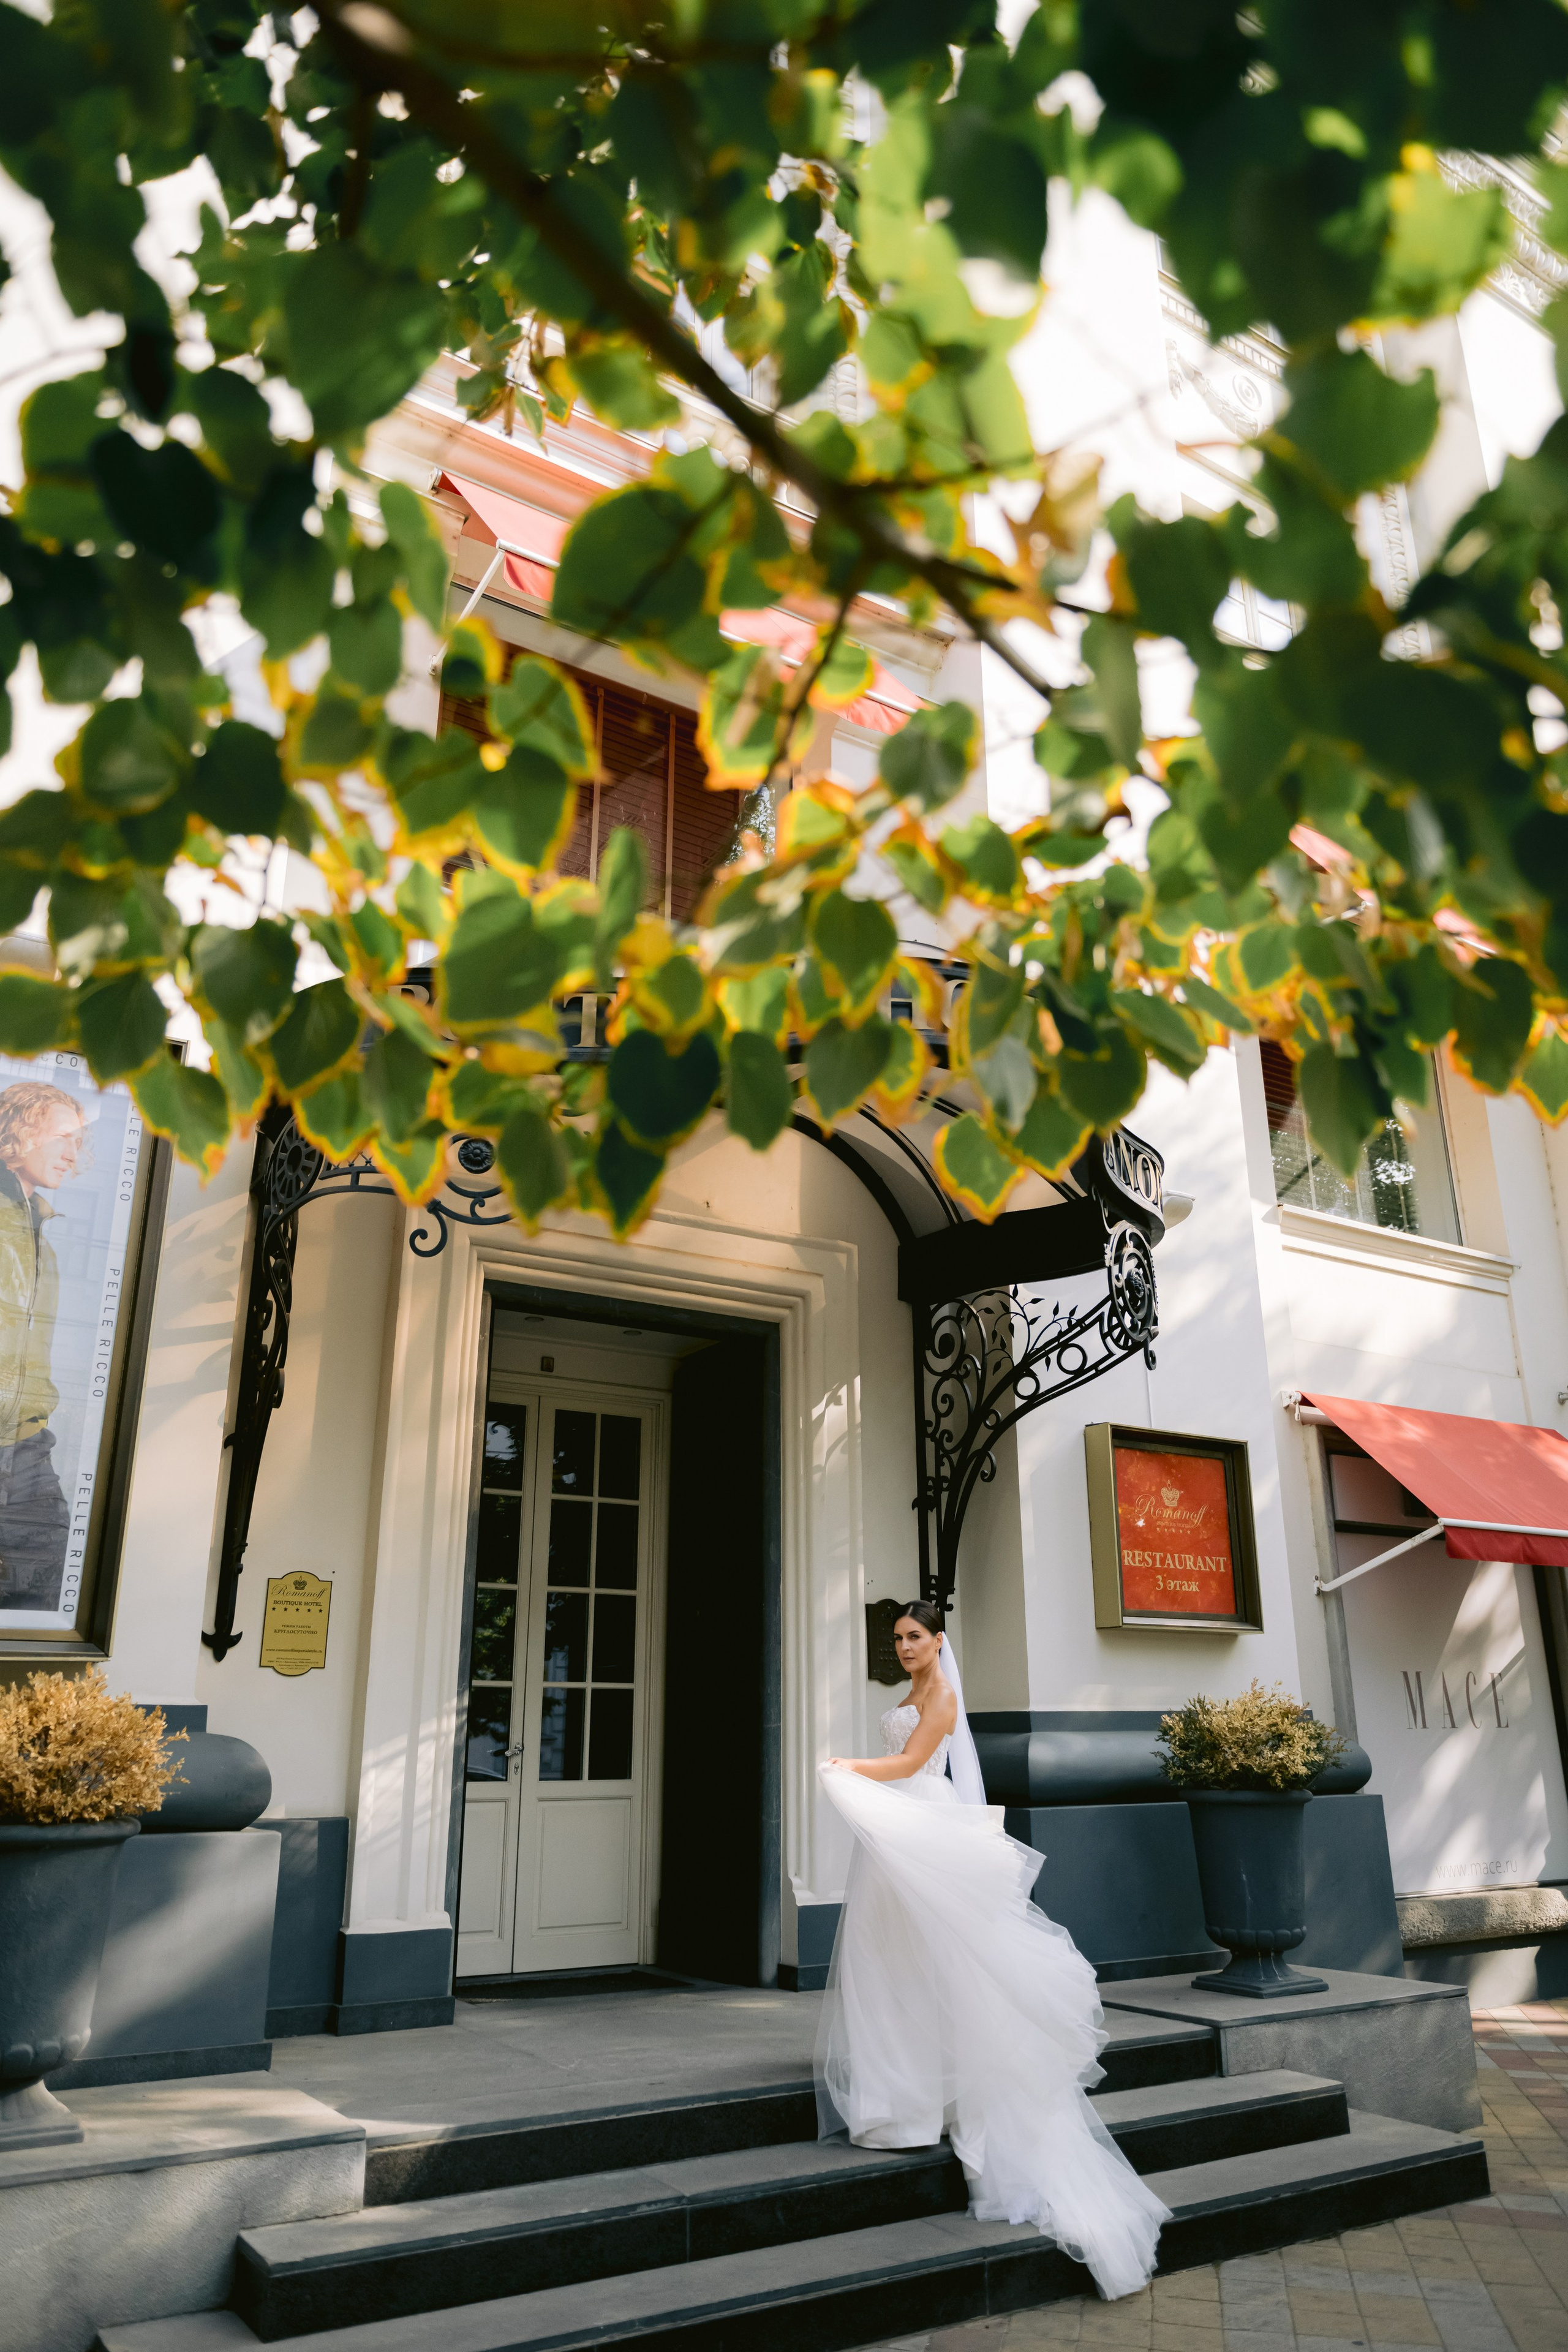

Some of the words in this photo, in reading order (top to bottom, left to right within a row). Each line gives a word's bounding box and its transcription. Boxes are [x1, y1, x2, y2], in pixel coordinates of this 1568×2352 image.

[120, 1147, 137, 1201] RICCO
[102, 1268, 121, 1327] PELLE
[92, 1339, 111, 1397] RICCO
[73, 1473, 92, 1536] PELLE
[1135, 1493, 1209, 1528] Romanoff
[62, 1550, 82, 1612] RICCO
[1123, 1550, 1227, 1572] RESTAURANT
[1155, 1575, 1164, 1591] 3
[1167, 1580, 1200, 1592] этаж
[271, 1584, 328, 1600] Romanoff
[1400, 1671, 1509, 1729] MACE
[1435, 1860, 1517, 1879] www.mace.ru
